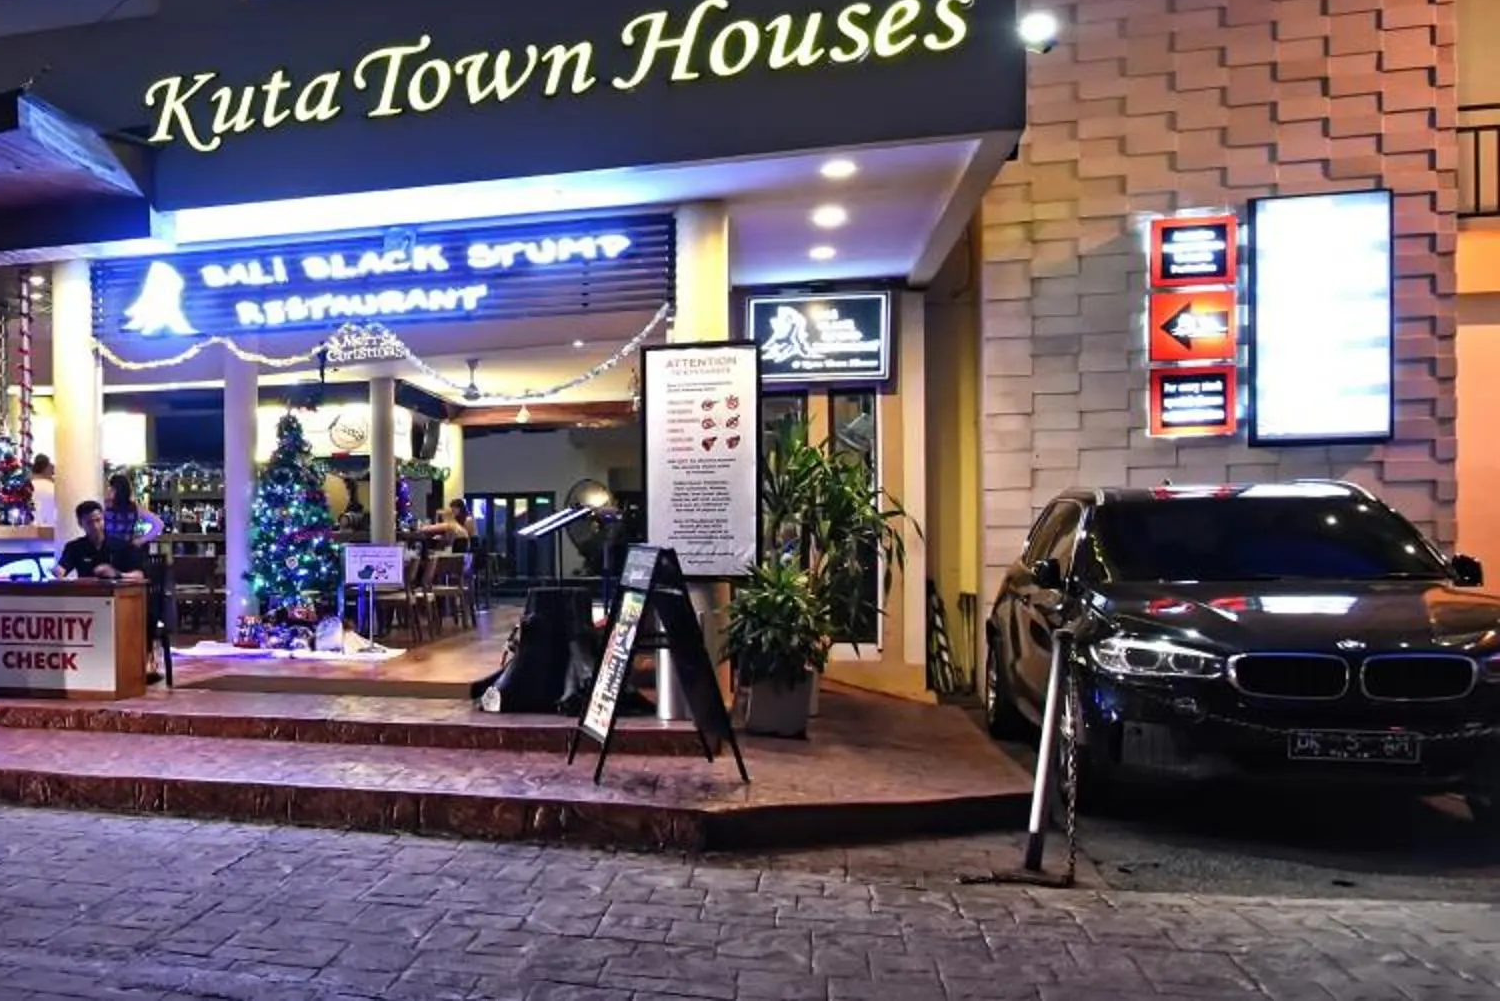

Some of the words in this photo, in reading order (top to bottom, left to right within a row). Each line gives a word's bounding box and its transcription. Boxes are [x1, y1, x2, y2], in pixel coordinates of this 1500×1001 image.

[145, 70, 341, 152] Kuta
[354, 34, 596, 117] Town
[302, 244, 449, 280] BLACK
[466, 234, 632, 269] STUMP
[666, 356, 737, 368] ATTENTION
[2, 651, 78, 671] CHECK
